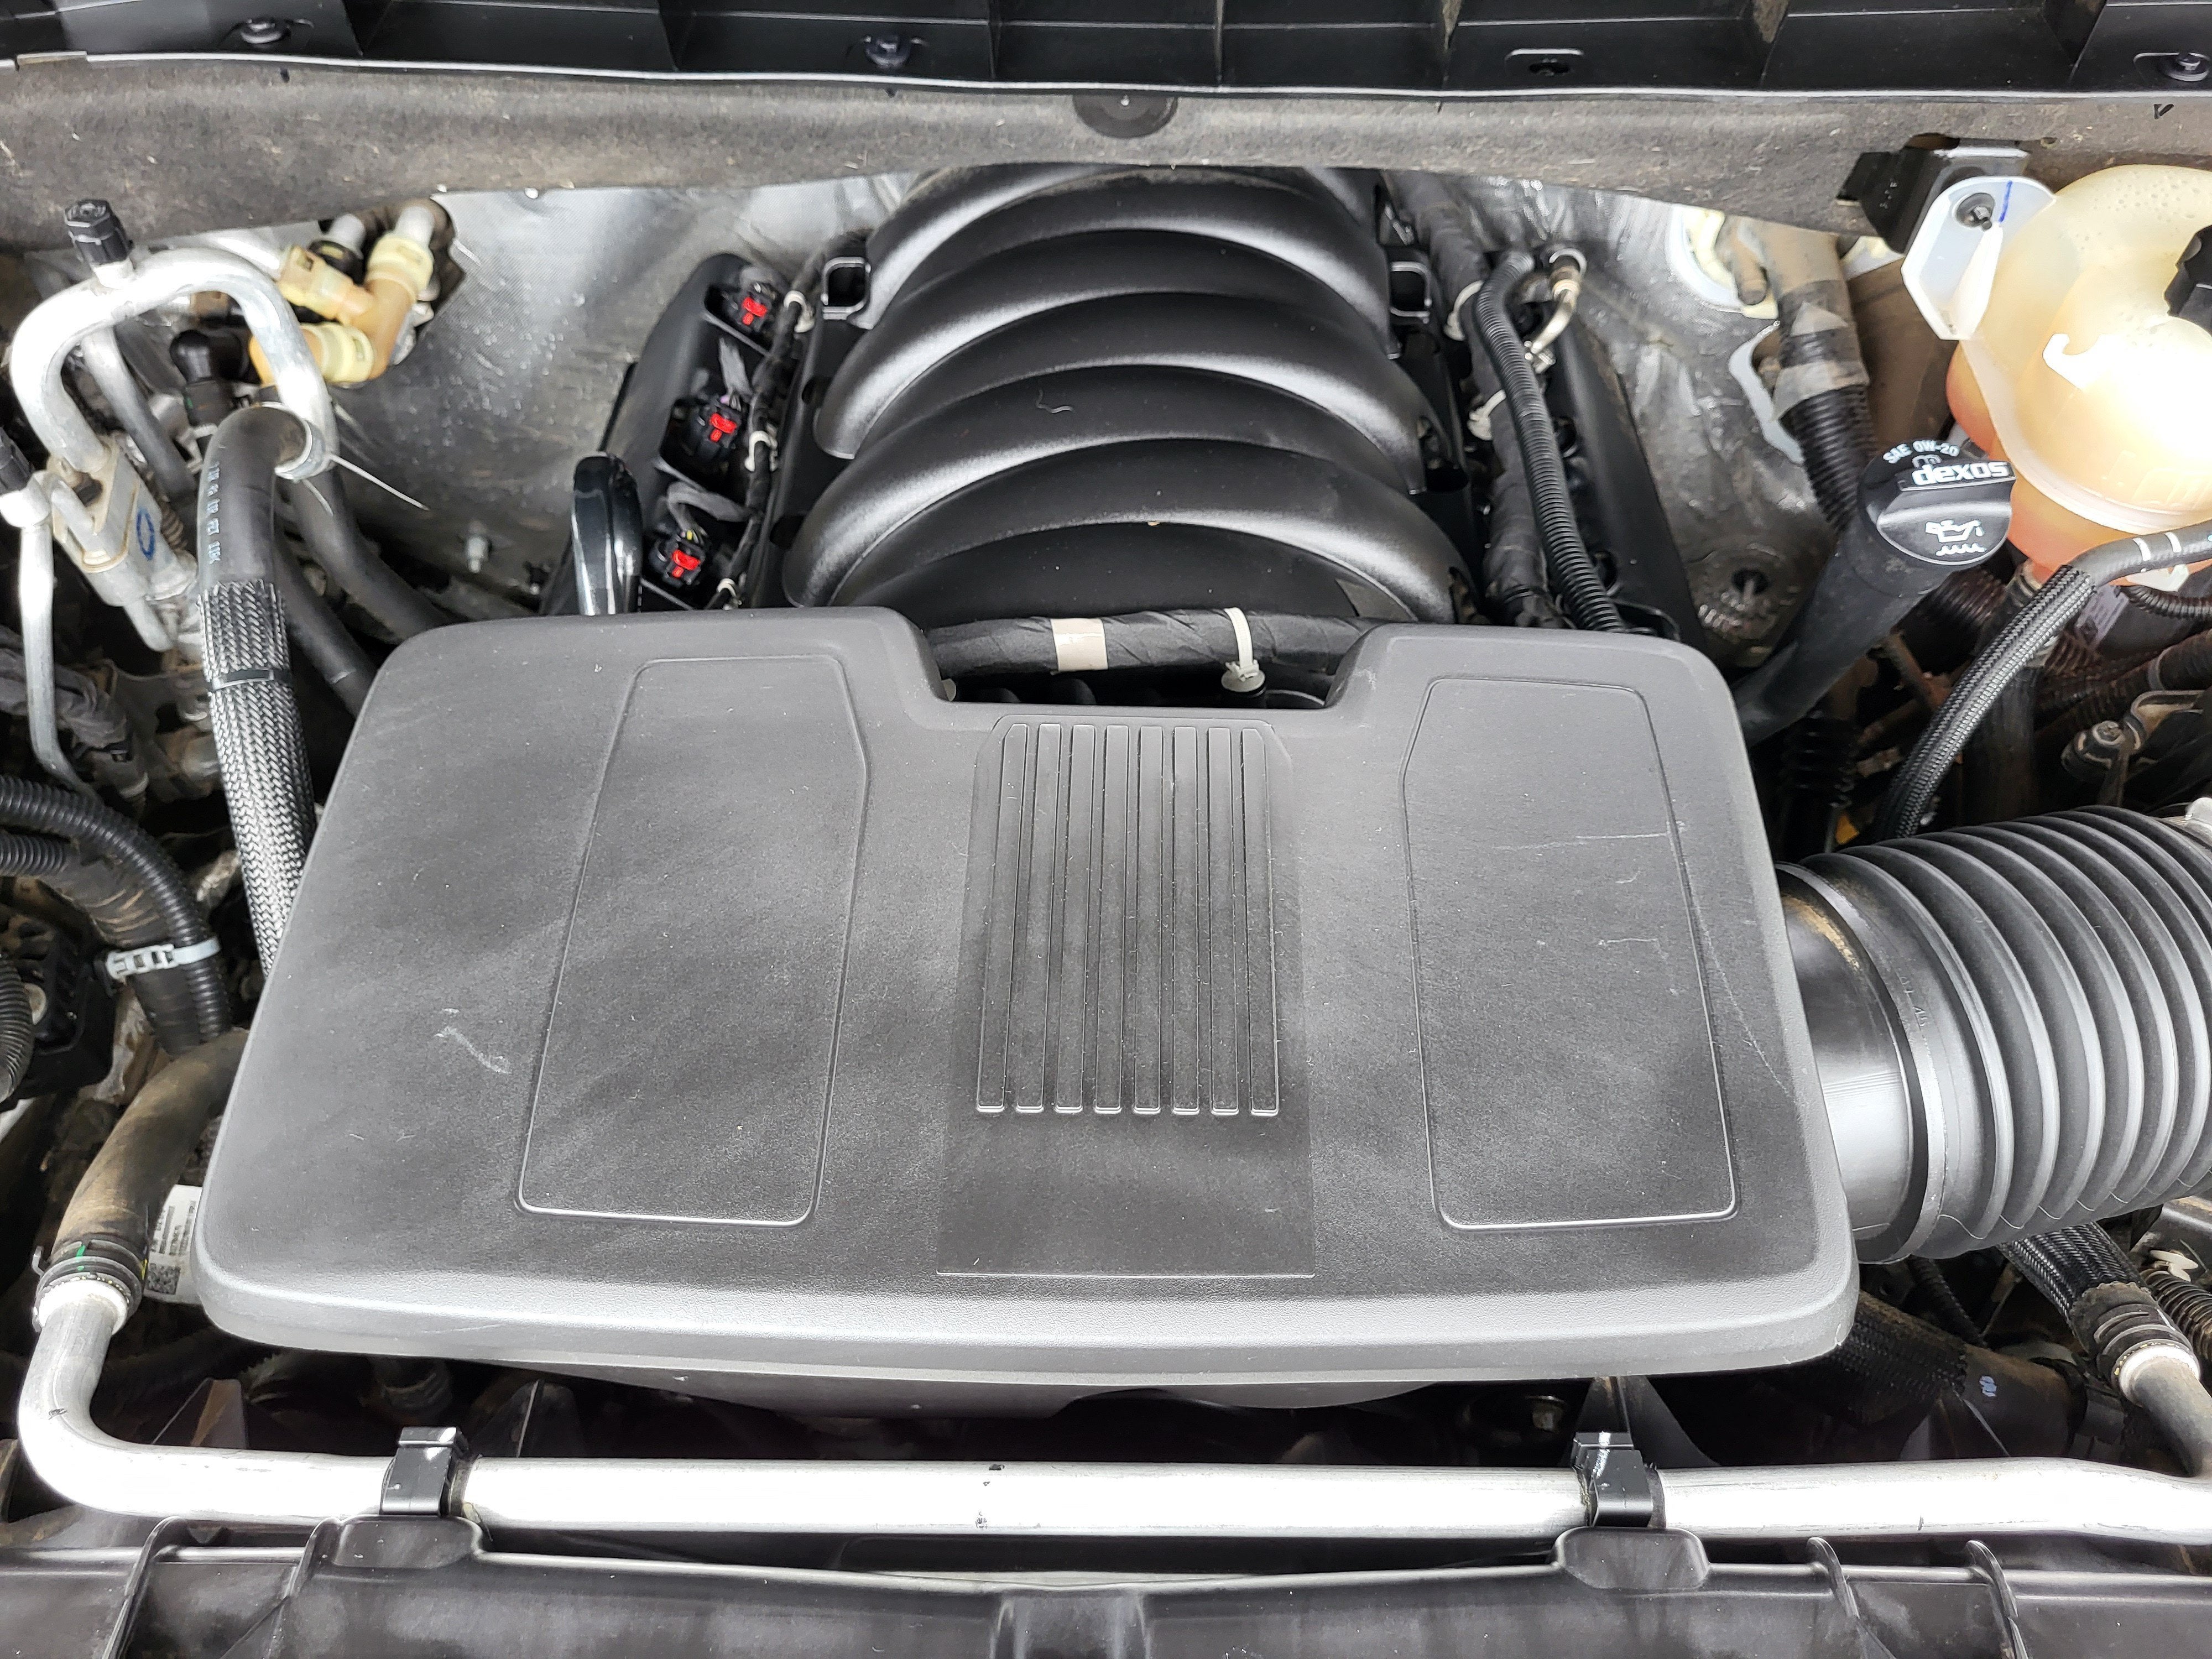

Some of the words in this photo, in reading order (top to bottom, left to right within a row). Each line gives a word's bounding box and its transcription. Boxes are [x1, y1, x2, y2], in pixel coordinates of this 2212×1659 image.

[1882, 443, 1913, 464] SAE
[1912, 440, 1960, 457] 0W-20
[1912, 461, 2010, 486] dexos
